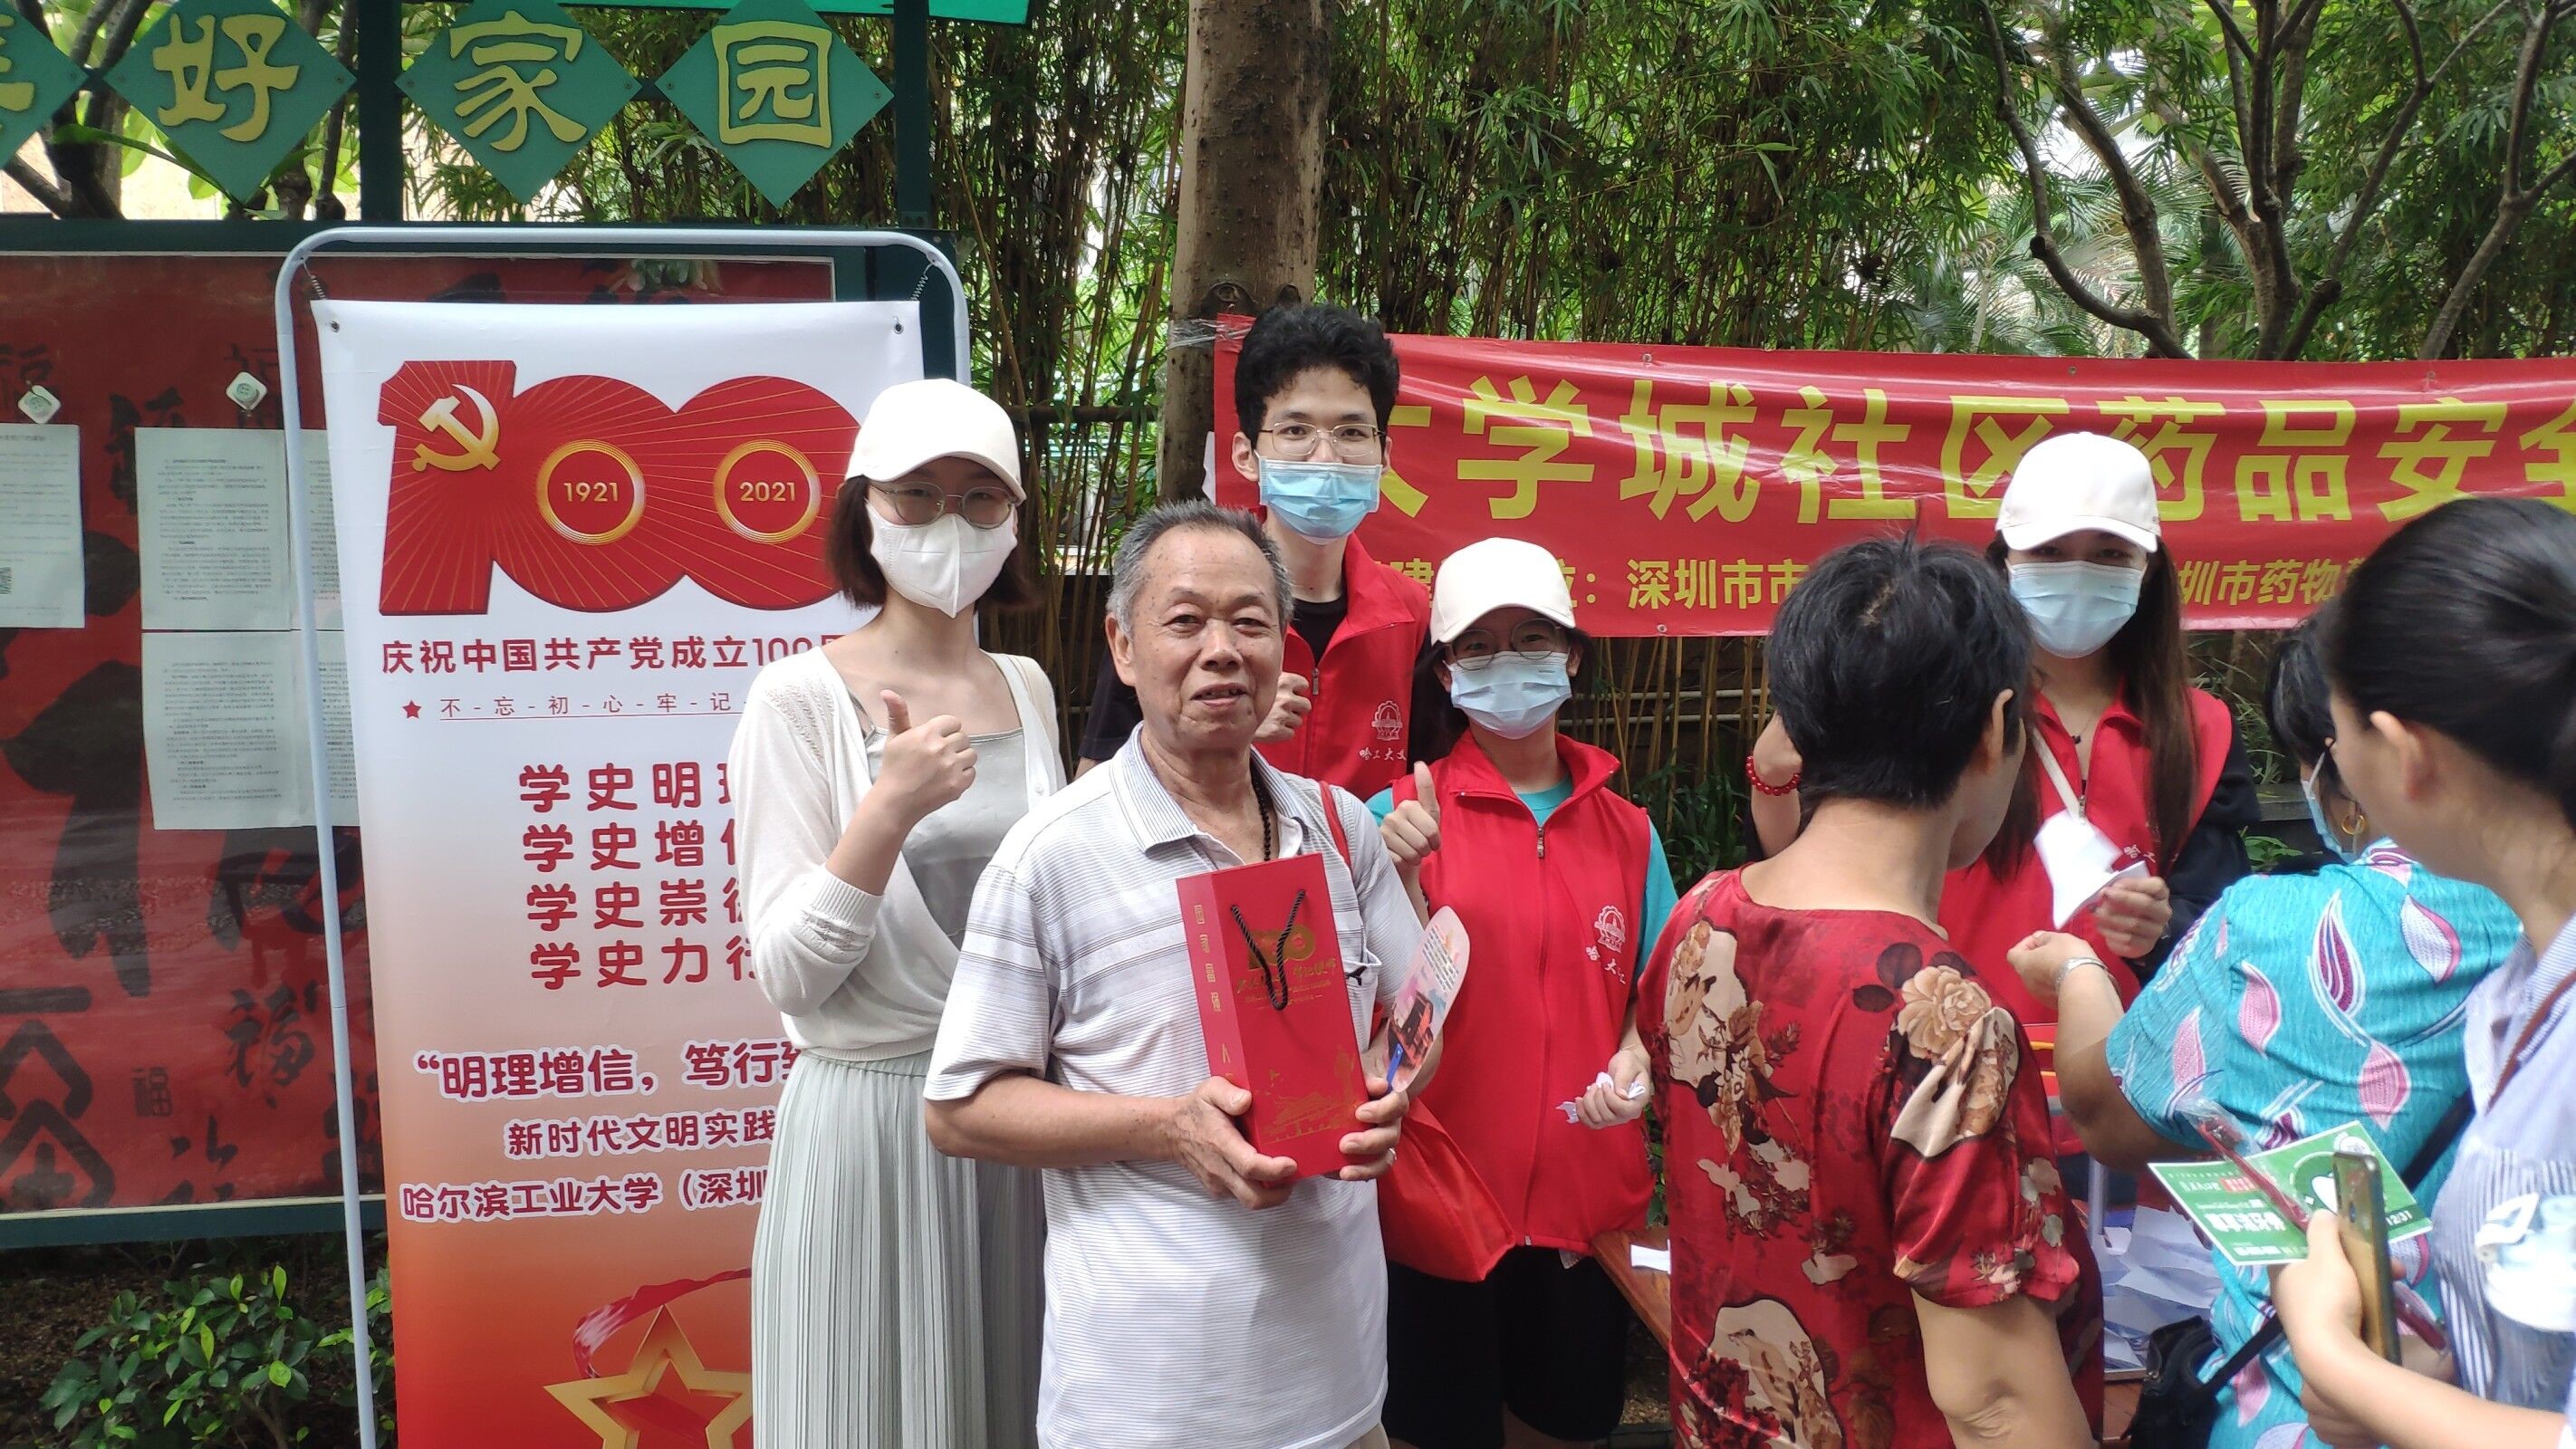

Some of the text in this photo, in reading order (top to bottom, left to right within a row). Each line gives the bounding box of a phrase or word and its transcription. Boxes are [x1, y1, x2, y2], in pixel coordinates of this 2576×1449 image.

[563, 482, 620, 503] 1921
[738, 482, 797, 502] 2021
[523, 818, 735, 873] 学史增
